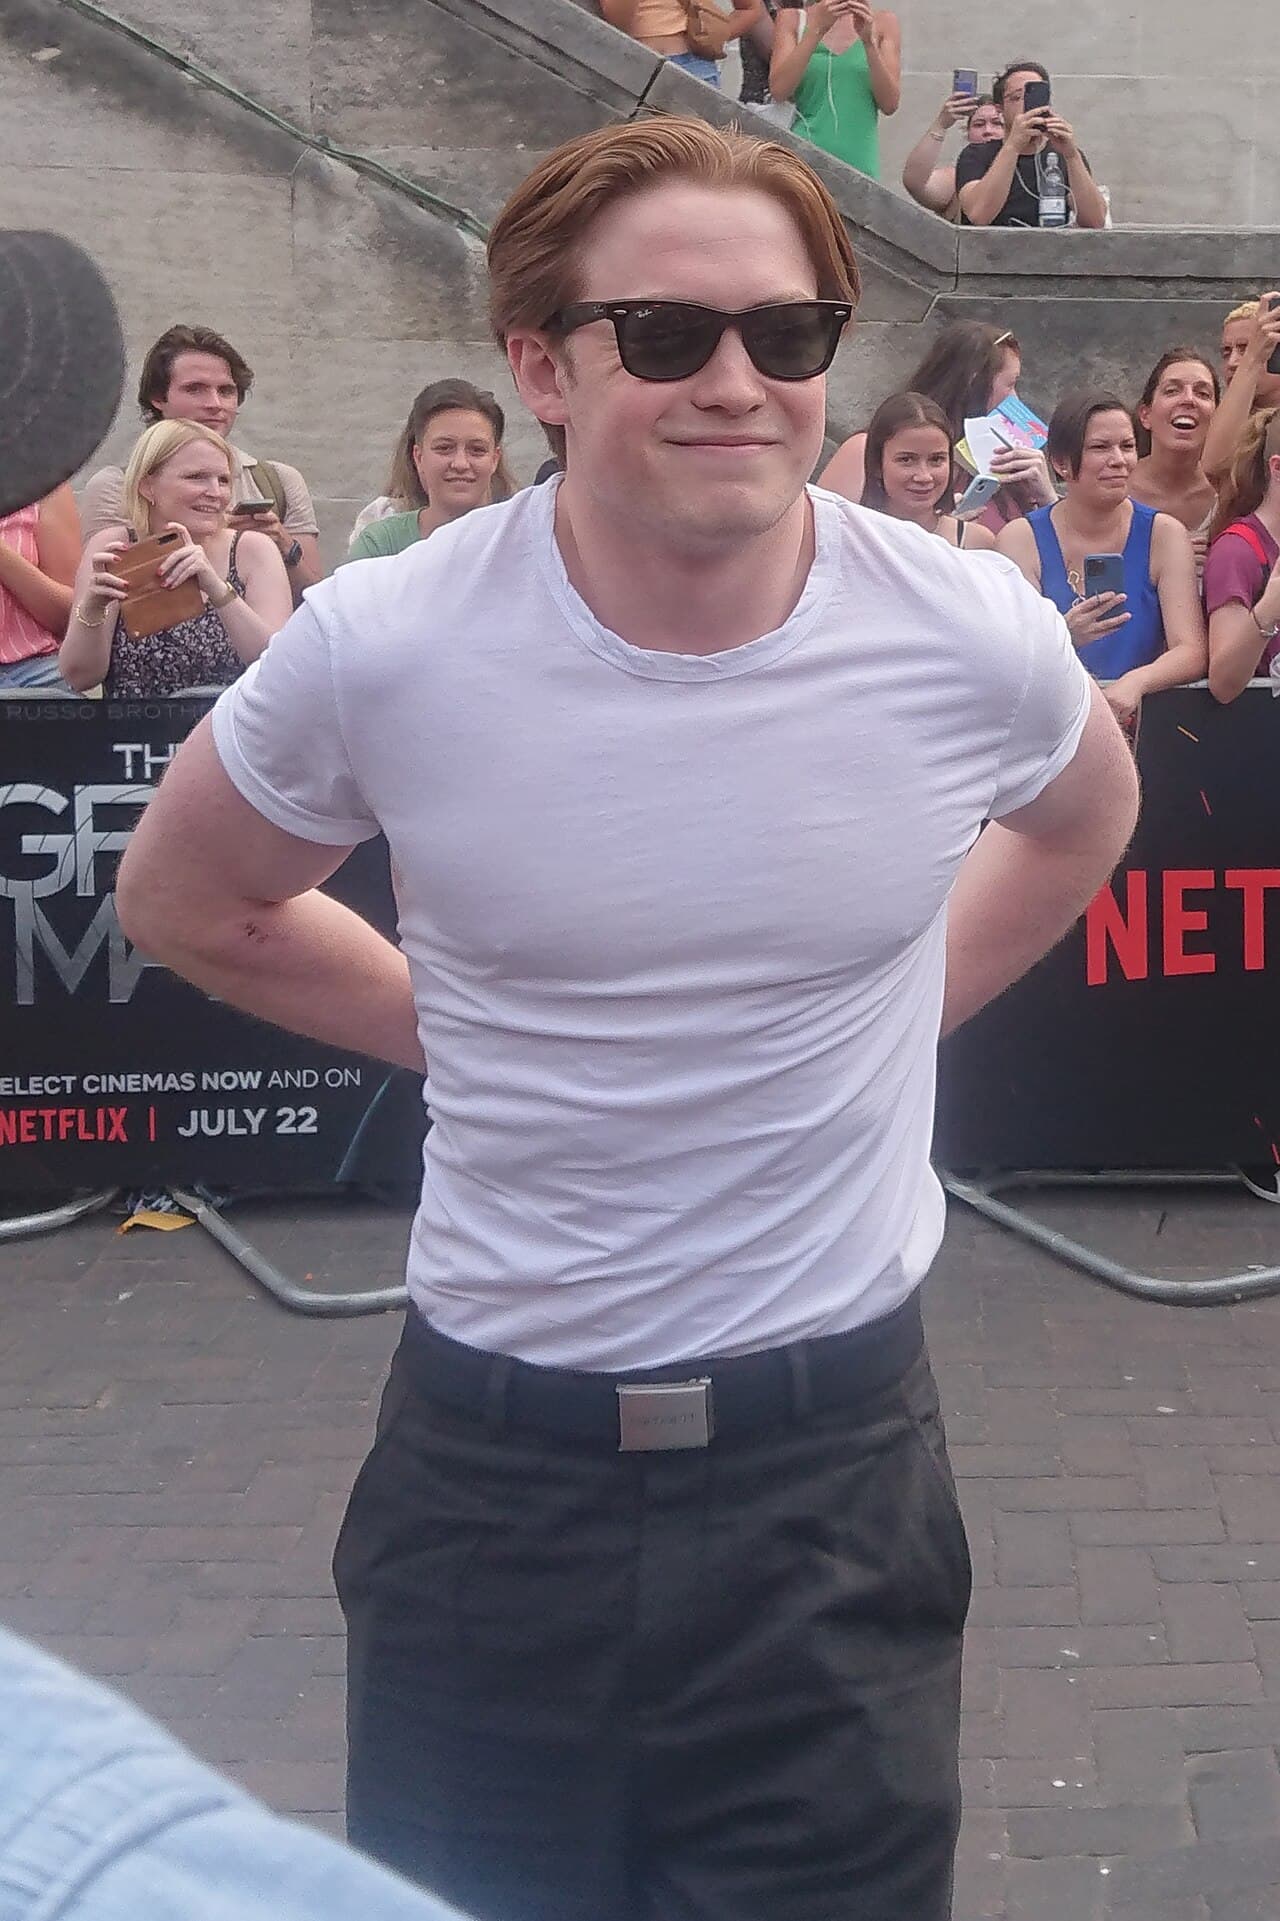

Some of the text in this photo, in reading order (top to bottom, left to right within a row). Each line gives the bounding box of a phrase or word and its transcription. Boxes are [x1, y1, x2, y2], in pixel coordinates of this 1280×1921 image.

[7, 703, 203, 720] RUSSO BROTH
[113, 743, 183, 779] TH
[1087, 869, 1280, 986] NET
[0, 1068, 361, 1096] ELECT CINEMAS NOW AND ON
[0, 1106, 318, 1145] NETFLIX JULY 22
